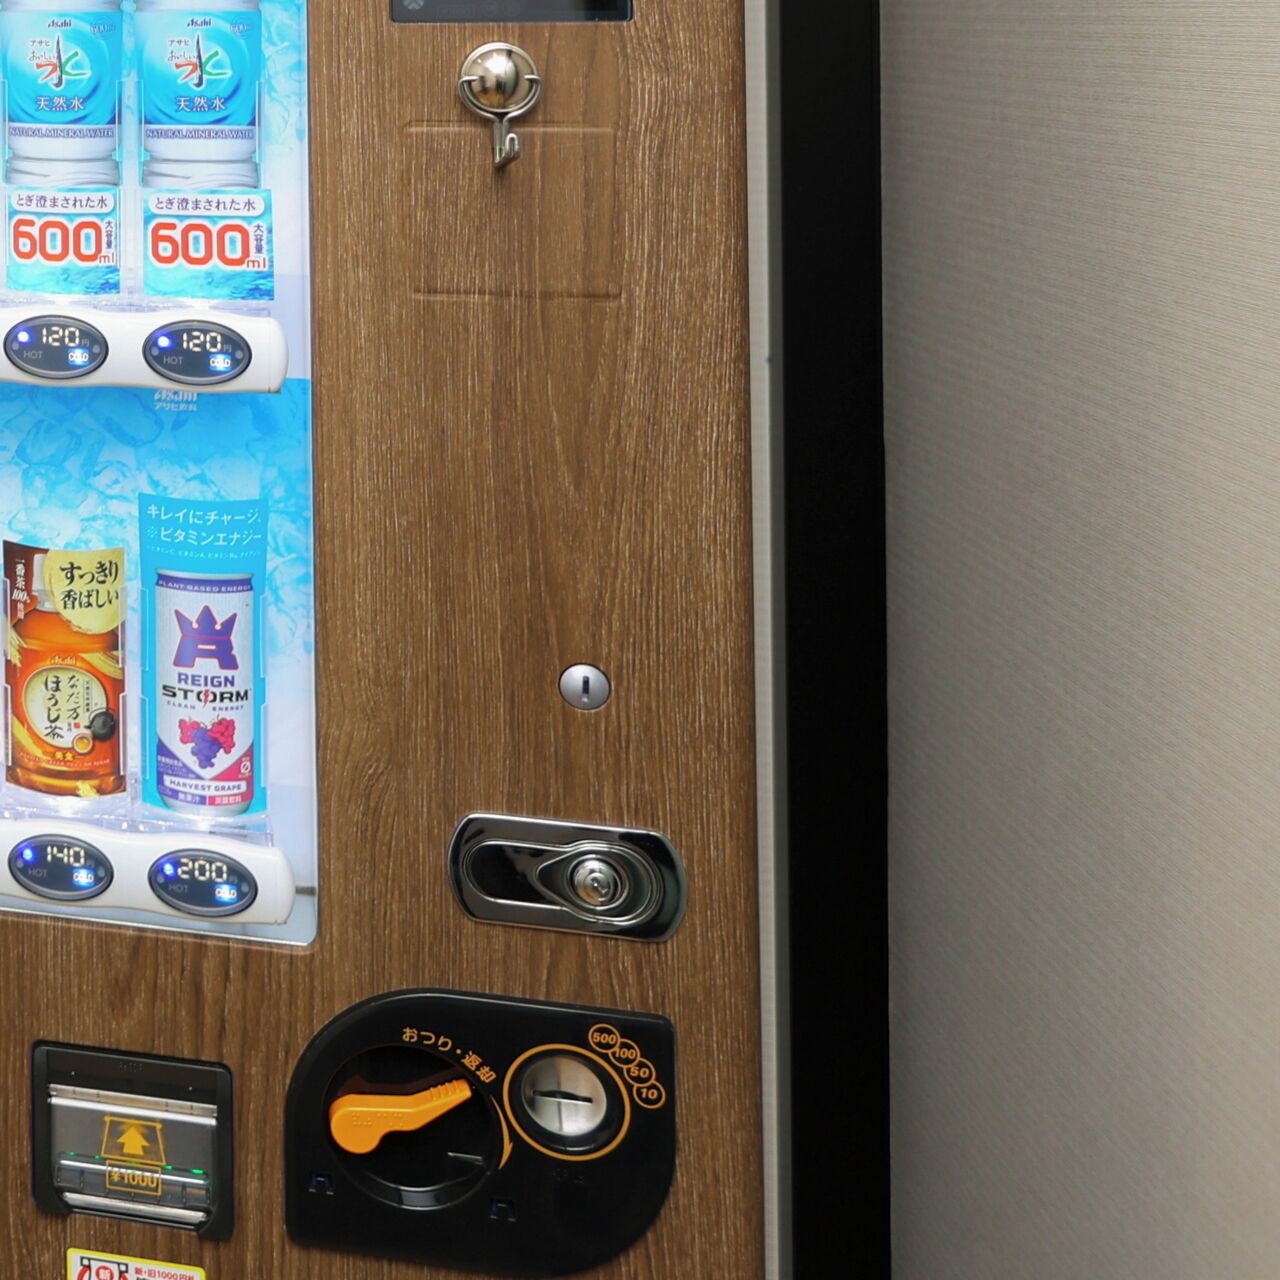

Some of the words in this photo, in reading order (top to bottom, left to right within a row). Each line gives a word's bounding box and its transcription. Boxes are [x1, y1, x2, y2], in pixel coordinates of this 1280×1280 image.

[36, 95, 85, 112] 天然水
[9, 127, 45, 138] NATURAL
[45, 127, 85, 138] MINERAL
[86, 127, 113, 138] WATER
[16, 192, 108, 210] とぎ澄まされた水
[13, 218, 103, 263] 600
[42, 326, 81, 347] 120
[59, 559, 119, 585] すっきり
[61, 589, 119, 611] 香ばしい
[177, 672, 235, 688] REIGN
[162, 684, 251, 704] STORM
[43, 675, 65, 741] ほうじ茶
[169, 777, 211, 792] HARVEST
[215, 783, 243, 792] GRAPE
[177, 858, 228, 882] 200
[592, 1032, 617, 1045] 500
[614, 1047, 637, 1060] 100
[629, 1066, 650, 1078] 50
[639, 1087, 658, 1100] 10
